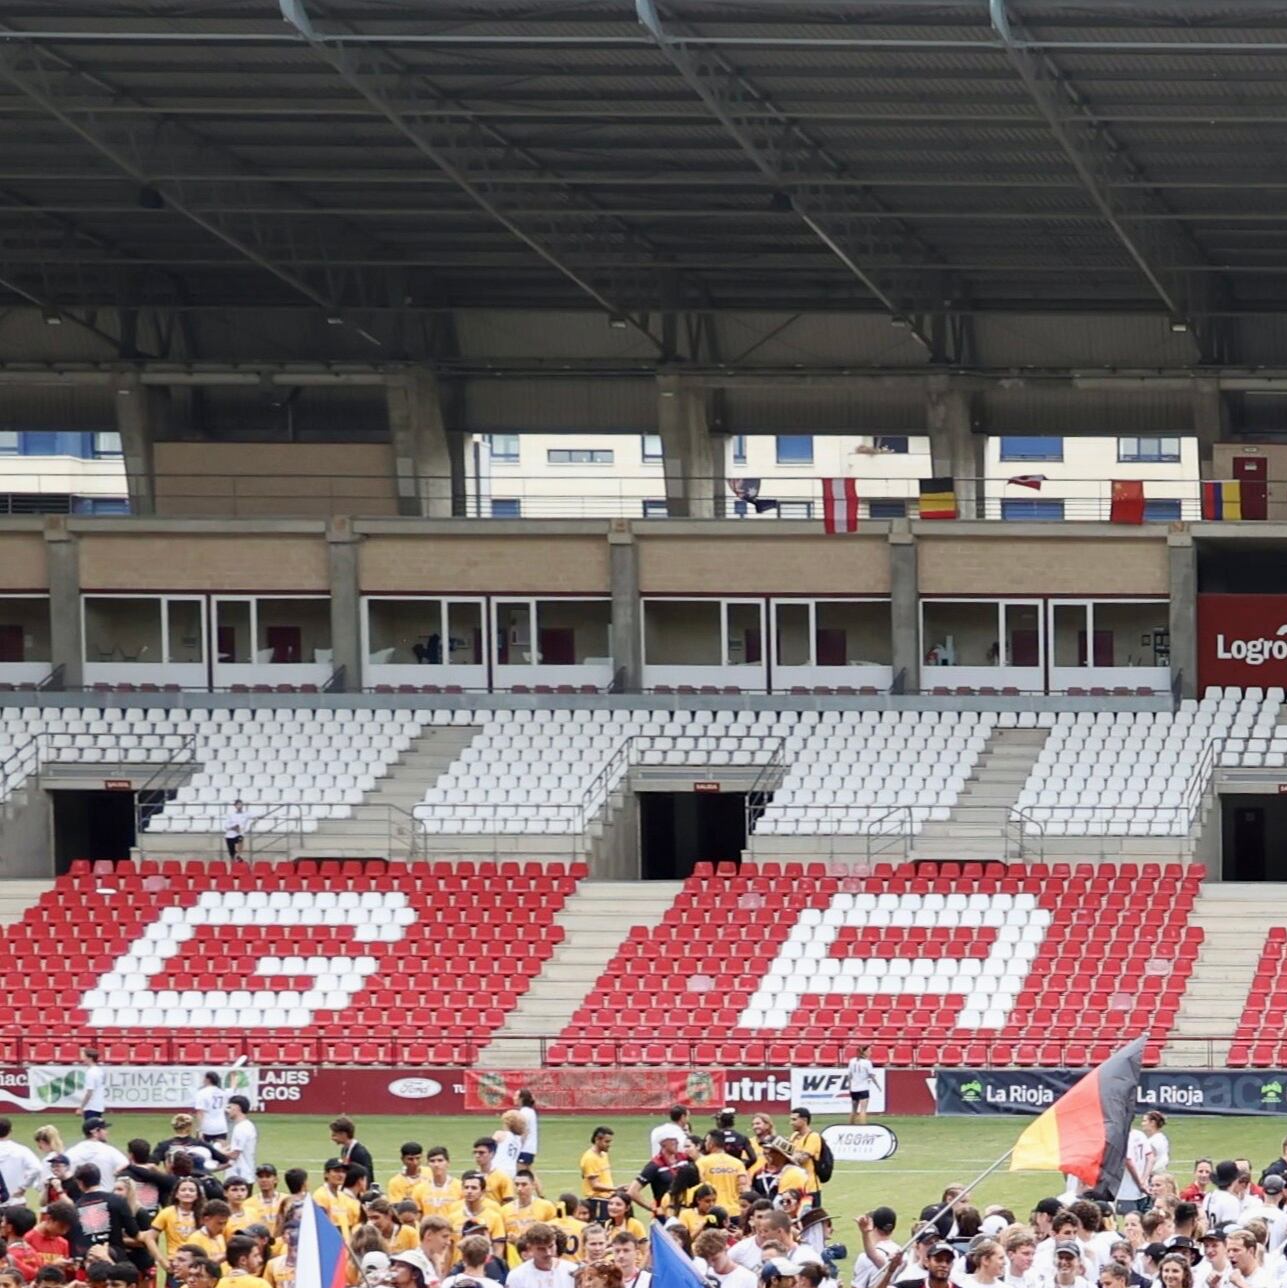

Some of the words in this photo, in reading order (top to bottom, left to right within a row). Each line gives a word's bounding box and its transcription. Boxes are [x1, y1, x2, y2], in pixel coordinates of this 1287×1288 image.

[987, 1085, 1006, 1102] La
[1009, 1085, 1053, 1105] Rioja
[1136, 1086, 1156, 1103] La
[1159, 1086, 1203, 1106] Rioja
